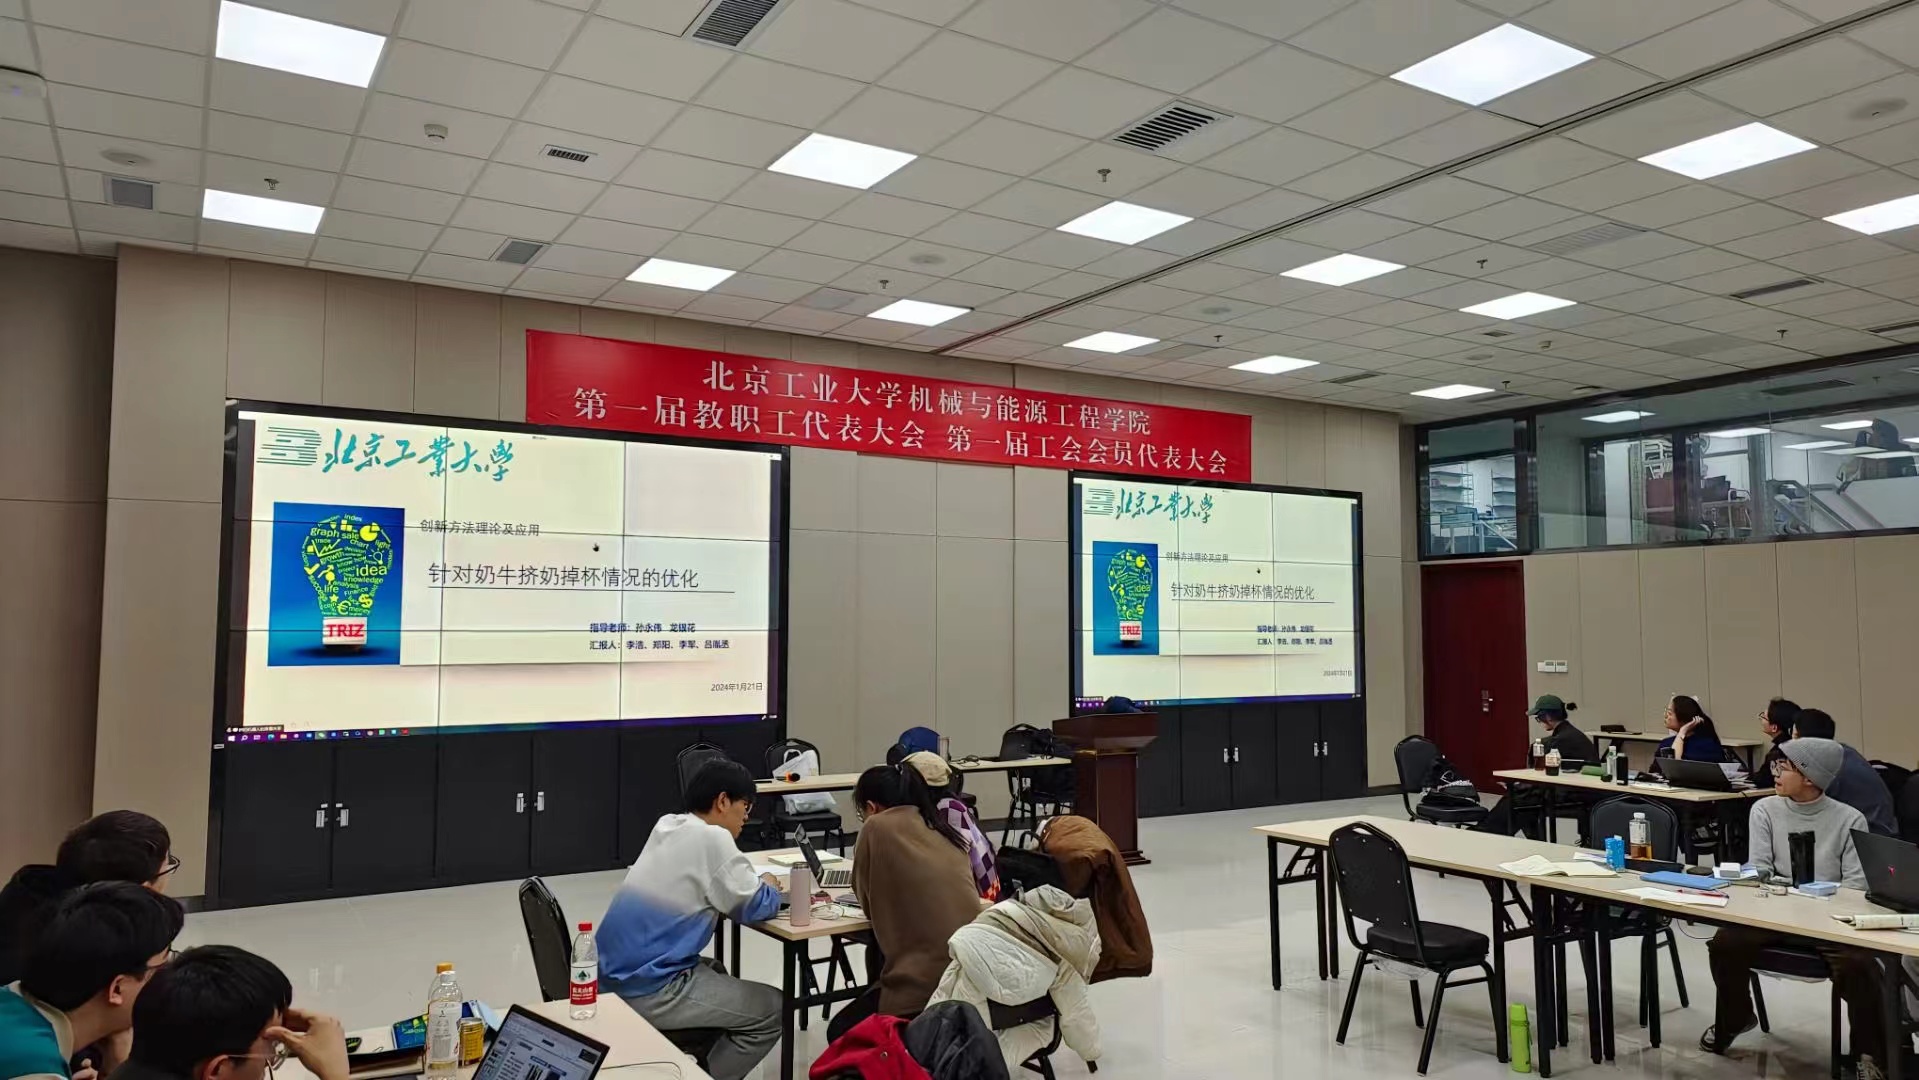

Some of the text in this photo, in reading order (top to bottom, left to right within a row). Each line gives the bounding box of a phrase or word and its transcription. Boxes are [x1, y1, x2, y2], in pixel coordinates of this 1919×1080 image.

[703, 360, 1152, 436] 北京工业大学机械与能源工程学院
[573, 387, 1228, 475] 第一届教职工代表大会 第一届工会会员代表大会
[310, 527, 340, 538] graph
[420, 519, 541, 537] 创新方法理论及应用
[355, 564, 388, 577] idea
[428, 562, 700, 588] 针对奶牛挤奶掉杯情况的优化
[344, 576, 384, 584] knowledge
[324, 585, 340, 593] life
[1171, 582, 1315, 600] 针对奶牛挤奶掉杯情况的优化
[326, 624, 365, 638] TRIZ
[1120, 625, 1141, 636] TRIZ
[711, 682, 763, 692] 2024年1月21日
